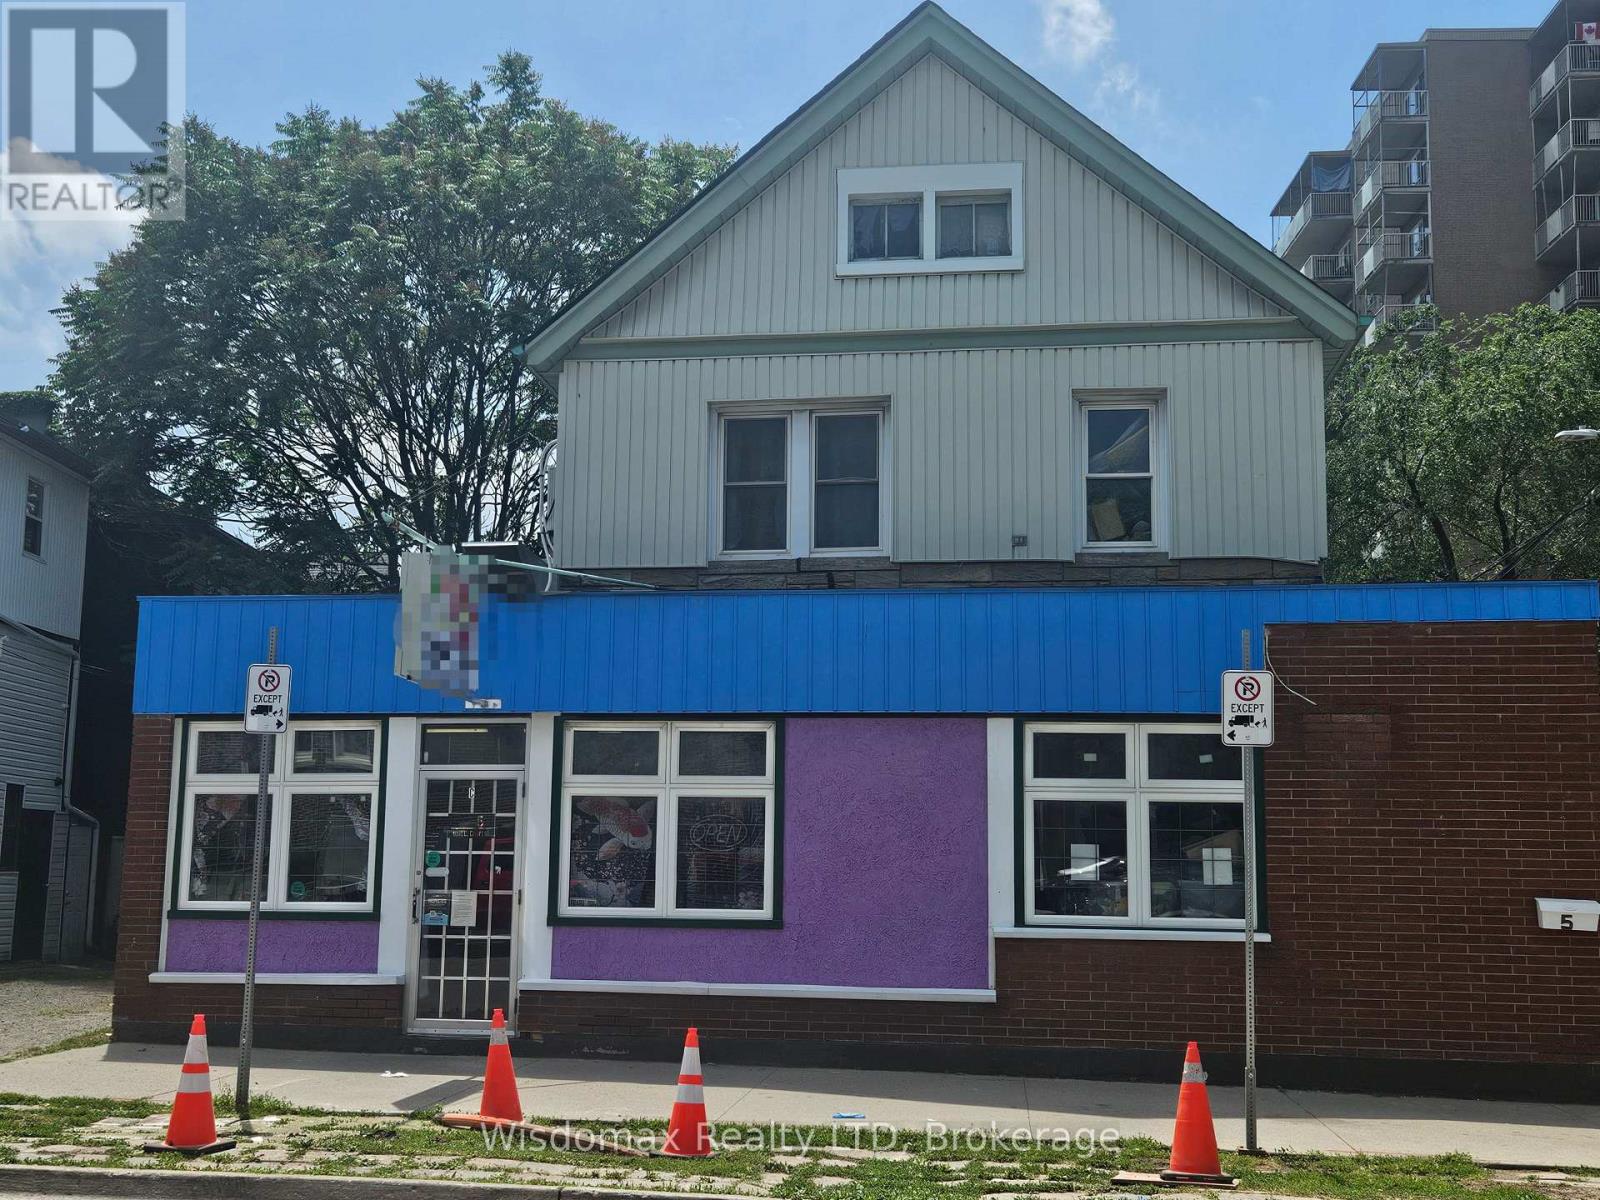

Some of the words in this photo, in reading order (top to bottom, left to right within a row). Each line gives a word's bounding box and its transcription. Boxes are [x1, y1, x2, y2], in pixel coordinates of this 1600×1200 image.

[254, 694, 283, 703] EXCEPT
[1231, 703, 1264, 713] EXCEPT
[693, 823, 742, 842] OPEN
[1560, 914, 1573, 931] 5
